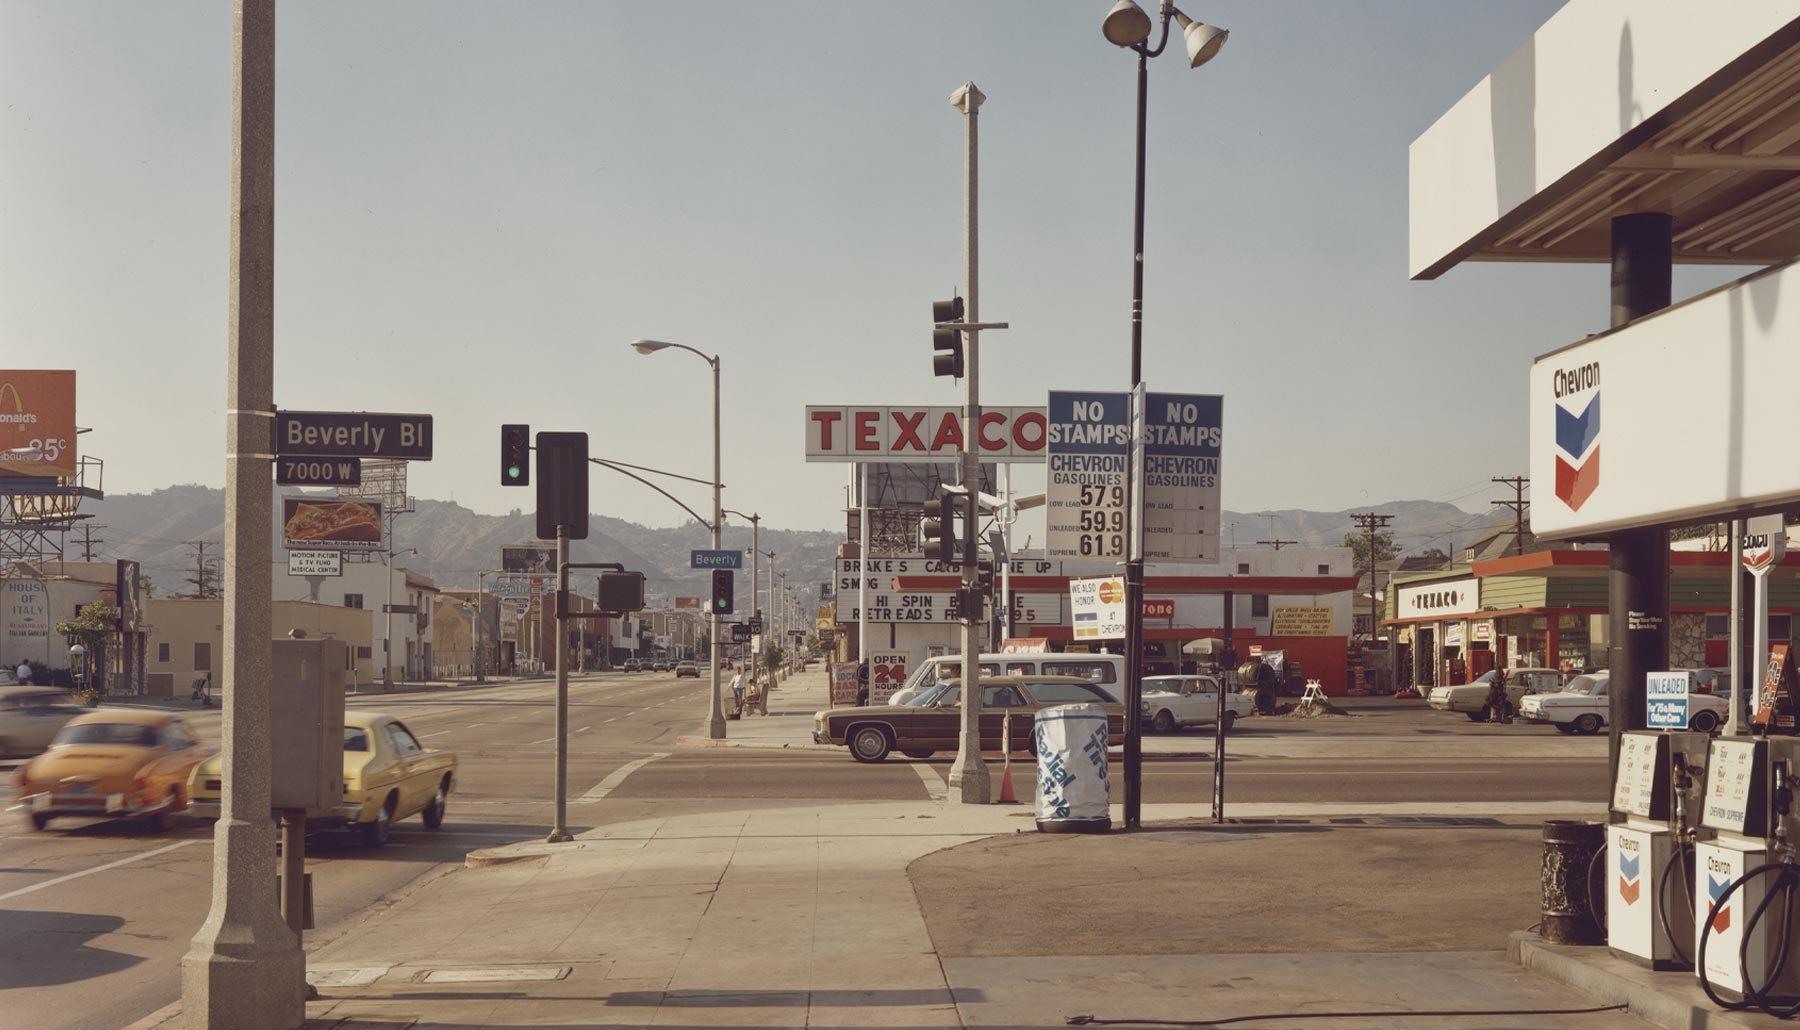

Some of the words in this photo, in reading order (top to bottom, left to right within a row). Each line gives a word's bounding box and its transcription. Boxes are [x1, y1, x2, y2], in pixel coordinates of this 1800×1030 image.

[1554, 361, 1600, 398] Chevron
[1073, 401, 1104, 422] NO
[1167, 403, 1198, 424] NO
[288, 420, 386, 453] Beverly
[401, 422, 424, 447] Bl
[811, 411, 1047, 452] TEXACO
[1049, 424, 1129, 445] STAMPS
[1145, 426, 1221, 448] STAMPS
[285, 462, 334, 480] 7000
[338, 462, 352, 480] W
[1051, 455, 1124, 473] CHEVRON
[1146, 457, 1217, 475] CHEVRON
[1054, 474, 1121, 486] GASOLINES
[1147, 476, 1214, 488] GASOLINES
[1081, 485, 1123, 508] 57.9
[1080, 511, 1123, 532] 59.9
[1080, 535, 1123, 556] 61.9
[696, 554, 737, 567] Beverly
[843, 562, 908, 574] BRAKES
[1036, 562, 1052, 573] UP
[1072, 584, 1081, 594] WE
[1082, 583, 1097, 593] ALSO
[21, 595, 37, 603] OF
[876, 596, 888, 607] HI
[903, 596, 932, 607] SPIN
[1075, 596, 1095, 606] HONOR
[1416, 590, 1458, 609] TEXACO
[13, 606, 43, 615] ITALY
[853, 609, 932, 621] RETREADS
[873, 655, 906, 664] OPEN
[873, 664, 906, 684] 24
[875, 683, 904, 691] HOURS
[1648, 678, 1686, 694] UNLEADED
[1619, 834, 1640, 853] Chevron
[1708, 855, 1731, 876] Chevron
